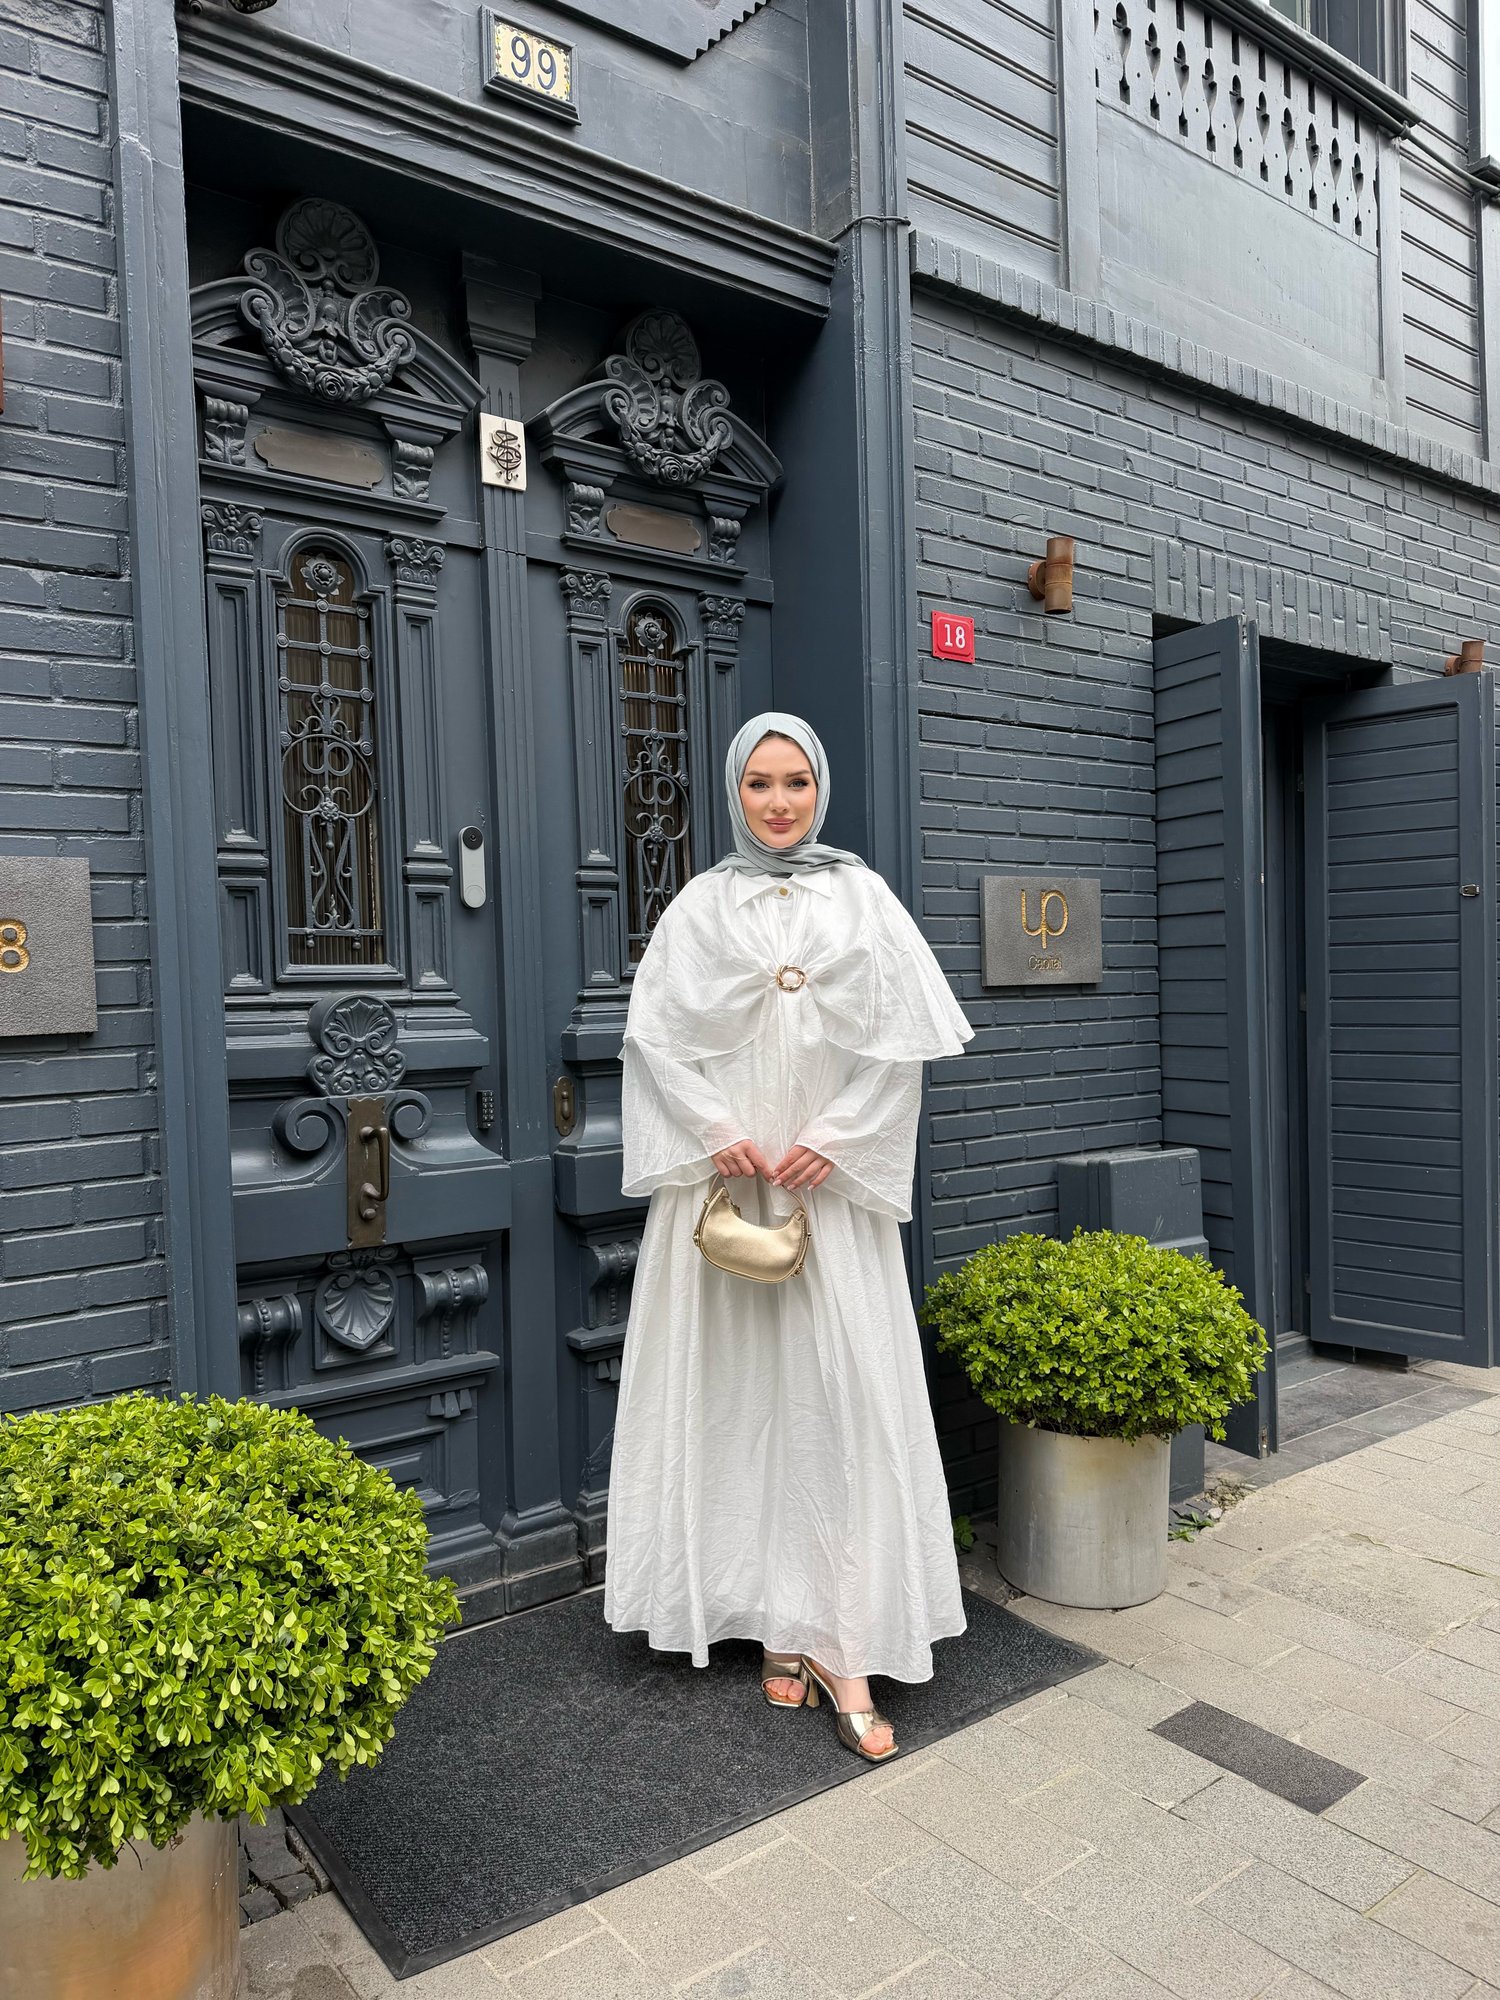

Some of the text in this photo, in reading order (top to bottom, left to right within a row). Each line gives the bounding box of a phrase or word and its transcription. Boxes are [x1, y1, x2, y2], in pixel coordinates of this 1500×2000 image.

[511, 36, 557, 90] 99
[944, 623, 966, 649] 18
[0, 918, 30, 974] 8
